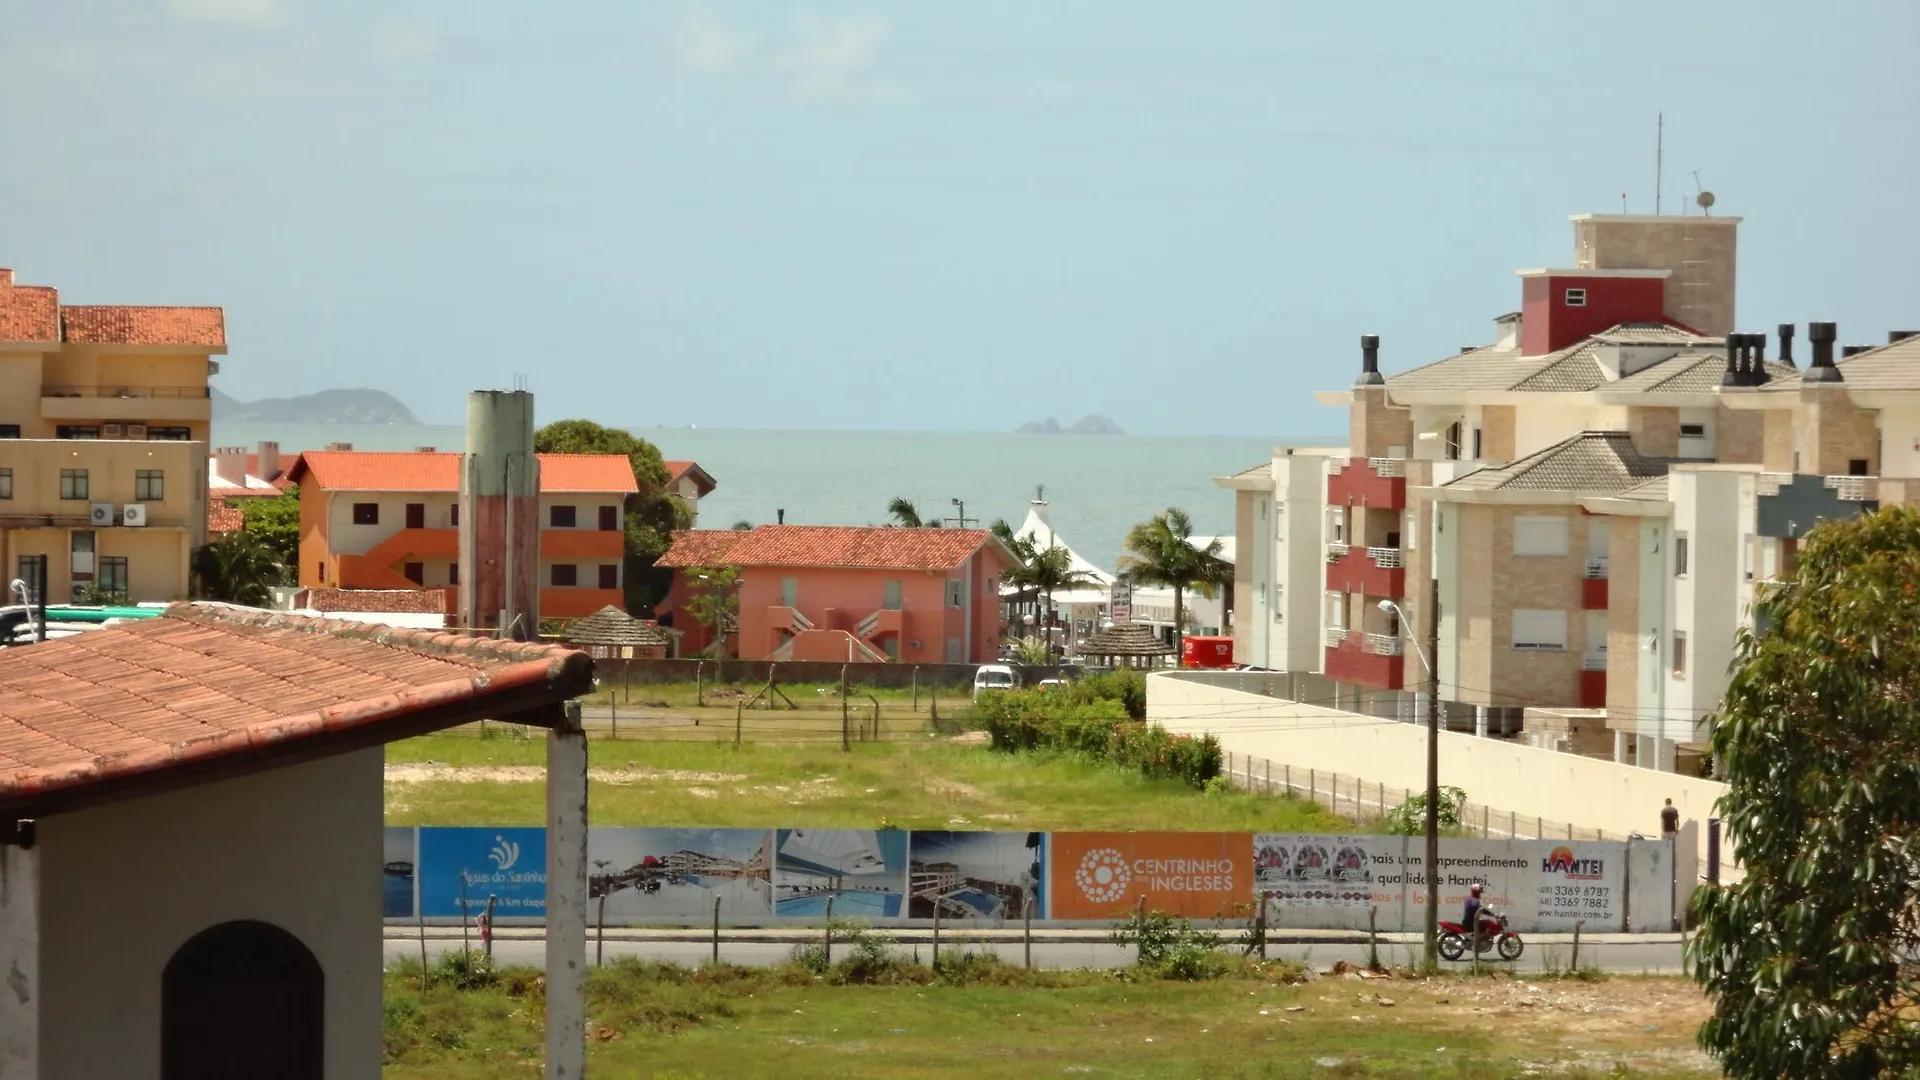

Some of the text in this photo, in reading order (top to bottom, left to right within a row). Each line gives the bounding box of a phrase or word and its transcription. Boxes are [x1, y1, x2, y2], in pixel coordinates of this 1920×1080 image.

[1133, 859, 1233, 874] CENTRINHO
[1436, 854, 1528, 869] mpreendimento
[1542, 858, 1603, 874] HANTEI
[1151, 876, 1233, 891] INGLESES
[1554, 886, 1580, 896] 3369
[1554, 897, 1580, 907] 3369
[1583, 898, 1609, 908] 7882
